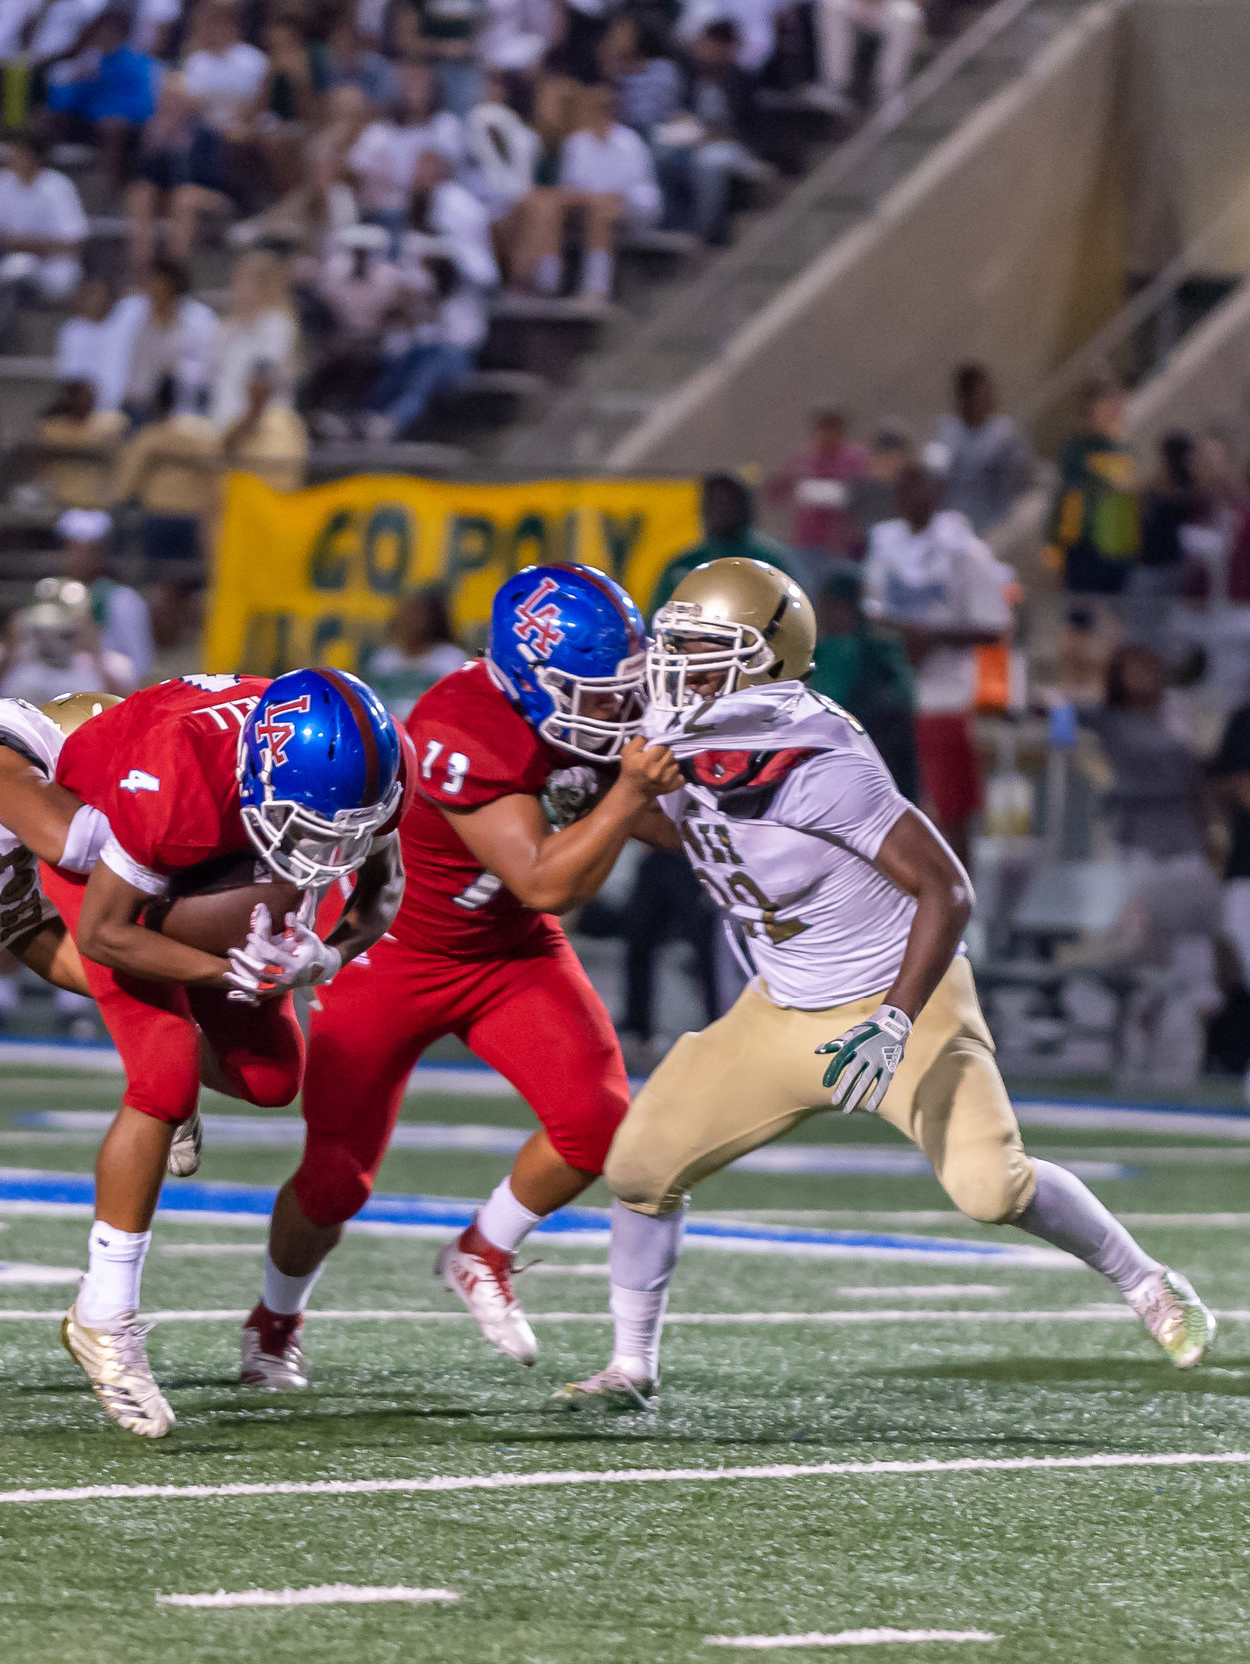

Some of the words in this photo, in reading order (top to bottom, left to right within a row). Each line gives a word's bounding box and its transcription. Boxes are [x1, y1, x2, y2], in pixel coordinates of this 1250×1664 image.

[513, 577, 565, 659] LA
[254, 694, 312, 768] LA
[119, 769, 161, 794] 4
